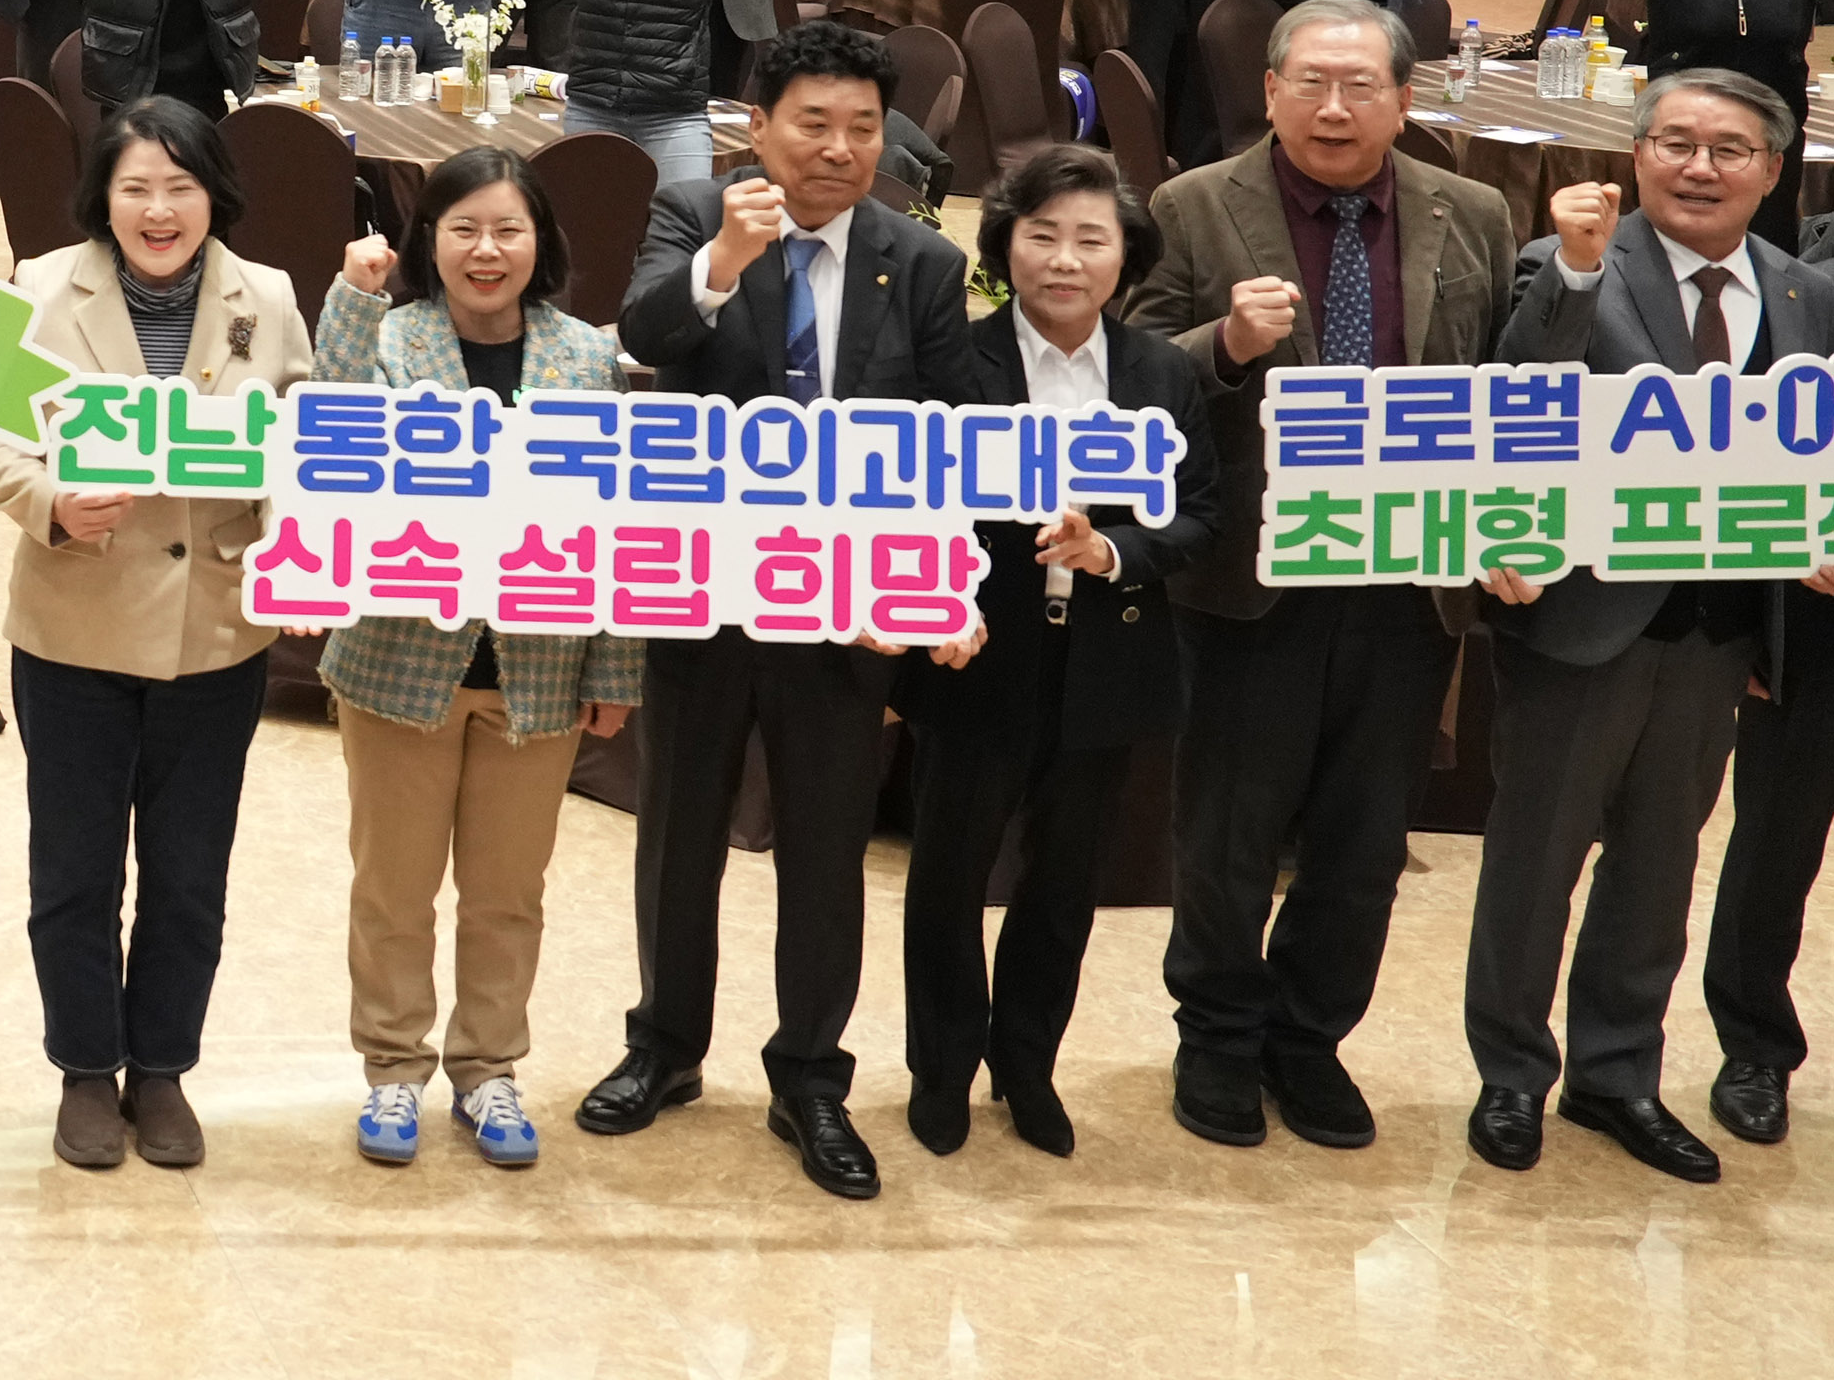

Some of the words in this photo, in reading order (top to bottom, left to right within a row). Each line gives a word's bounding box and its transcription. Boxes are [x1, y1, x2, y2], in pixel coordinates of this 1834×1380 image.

[57, 383, 270, 489] 전남
[295, 390, 502, 499] 통합
[528, 400, 1177, 518] 국립의과대학
[1278, 374, 1581, 466] 글로벌
[254, 517, 461, 619] 신속
[500, 524, 710, 628] 설립
[754, 526, 980, 635] 희망
[1270, 489, 1567, 579] 초대형
